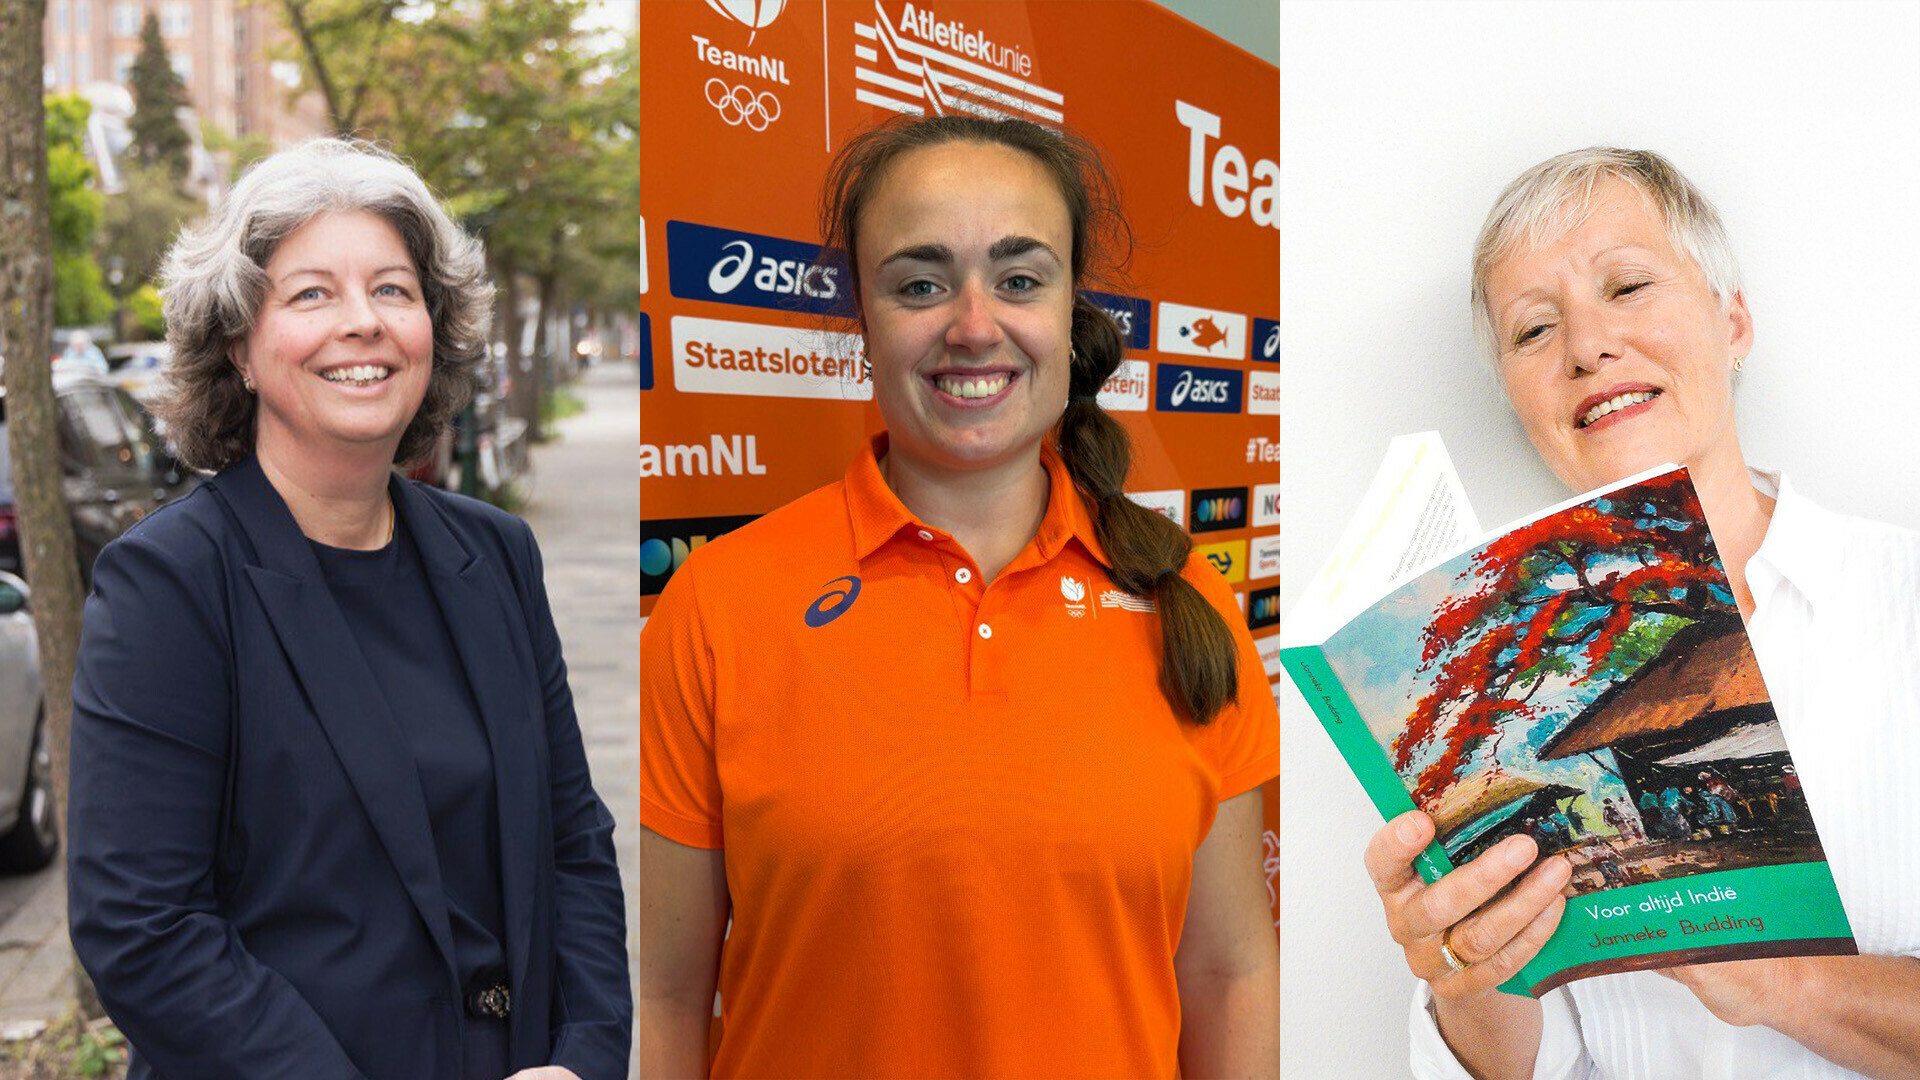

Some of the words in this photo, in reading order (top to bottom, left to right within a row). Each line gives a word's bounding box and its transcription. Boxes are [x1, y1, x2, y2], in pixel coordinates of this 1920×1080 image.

[691, 34, 790, 85] TeamNL
[900, 3, 1032, 77] Atletiekunie
[1175, 98, 1280, 231] Tea
[754, 256, 839, 299] asics
[684, 340, 865, 385] Staatsloterij
[1585, 904, 1631, 920] Voor
[1639, 891, 1684, 914] altijd
[1688, 886, 1737, 905] Indië
[1588, 925, 1668, 949] Janneke
[1679, 914, 1765, 935] Budding
